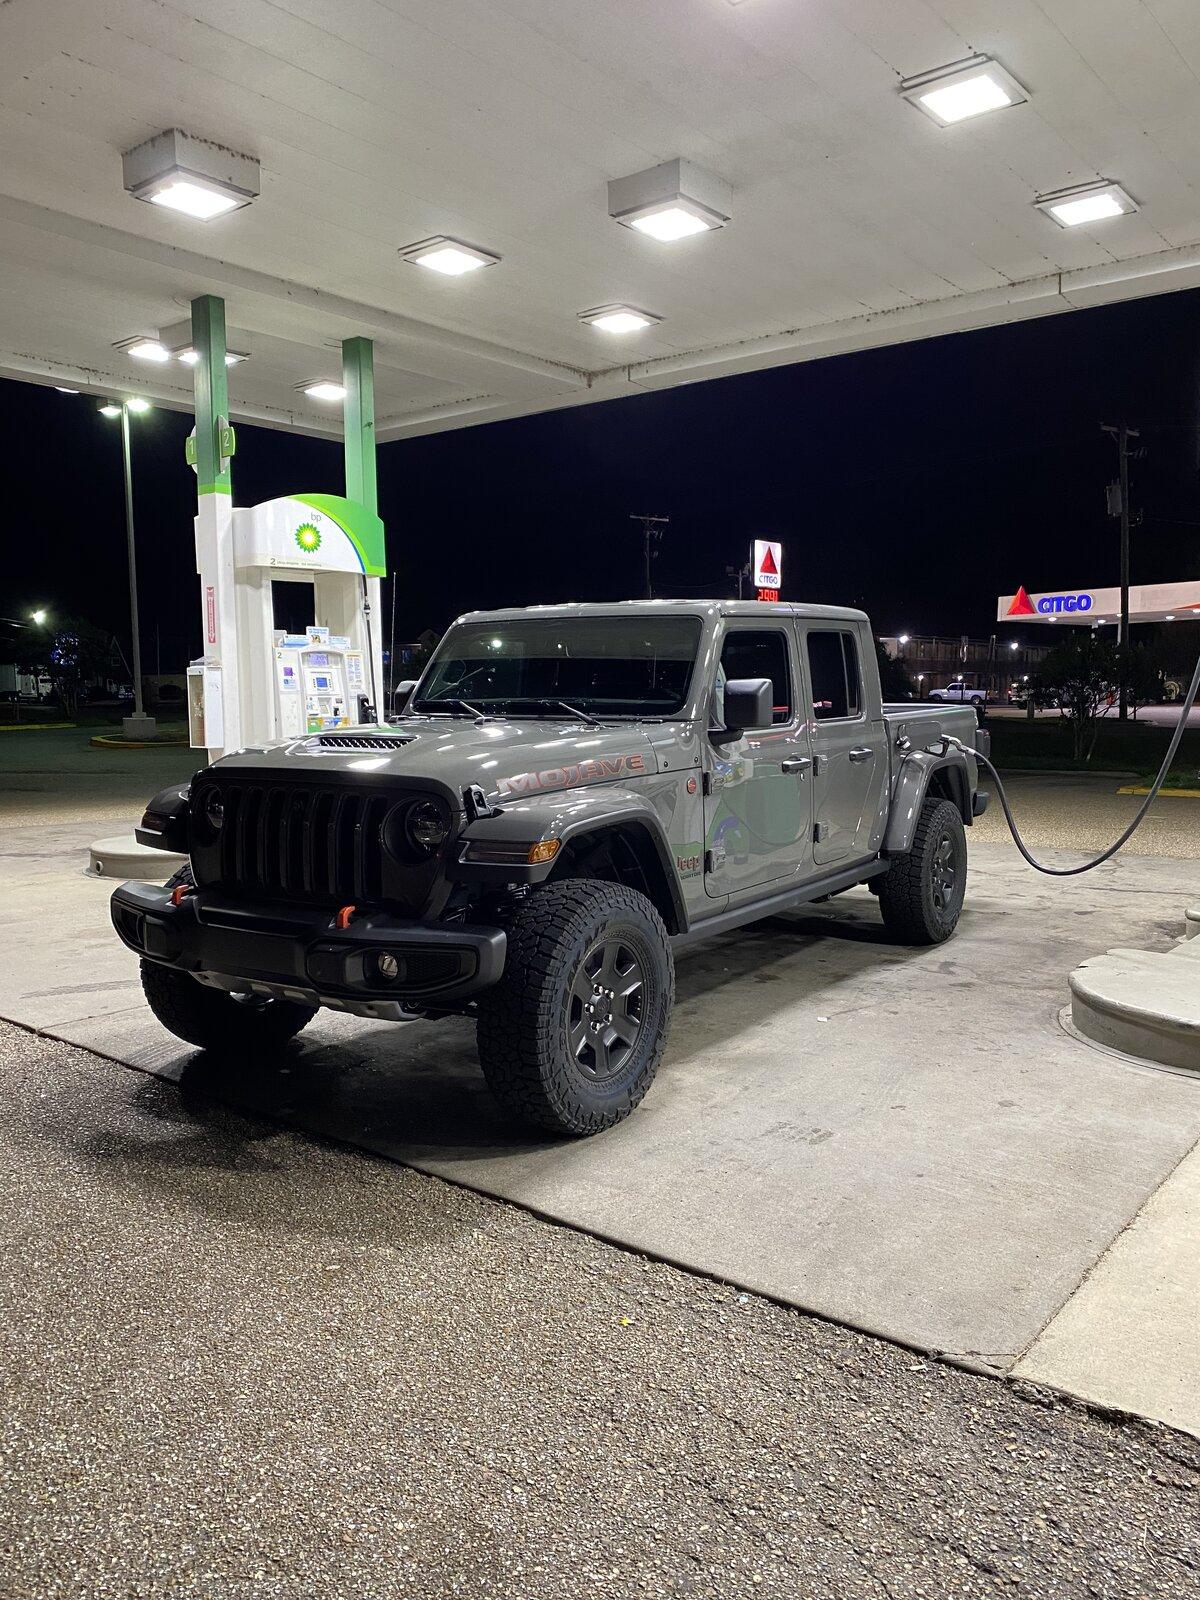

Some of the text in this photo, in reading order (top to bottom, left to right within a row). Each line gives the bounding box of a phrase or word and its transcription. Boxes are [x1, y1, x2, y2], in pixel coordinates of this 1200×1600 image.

[224, 431, 230, 447] 2
[311, 512, 322, 522] bp
[270, 557, 276, 565] 2
[759, 574, 778, 585] CITGO
[1037, 594, 1093, 614] CITGO
[496, 753, 646, 793] MOJAVE
[677, 856, 700, 871] Jeep
